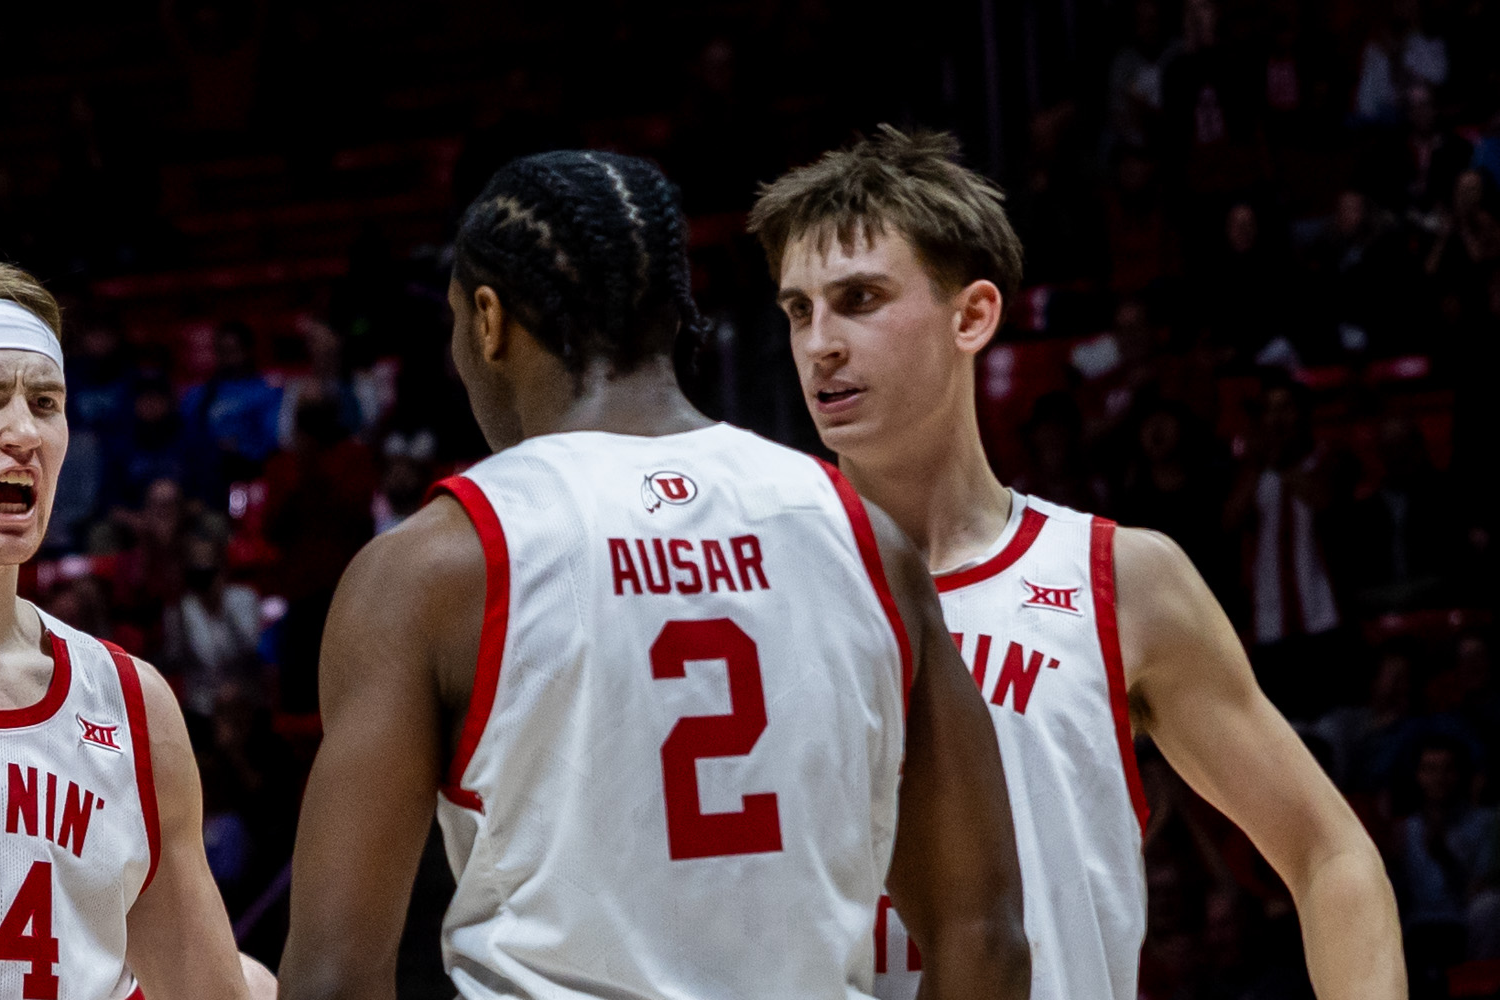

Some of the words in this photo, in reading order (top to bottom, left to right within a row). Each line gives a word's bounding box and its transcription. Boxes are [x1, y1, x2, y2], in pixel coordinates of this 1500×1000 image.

[656, 477, 688, 500] U
[609, 535, 770, 595] AUSAR
[1026, 582, 1078, 611] XII
[82, 719, 120, 749] XII
[649, 617, 783, 860] 2
